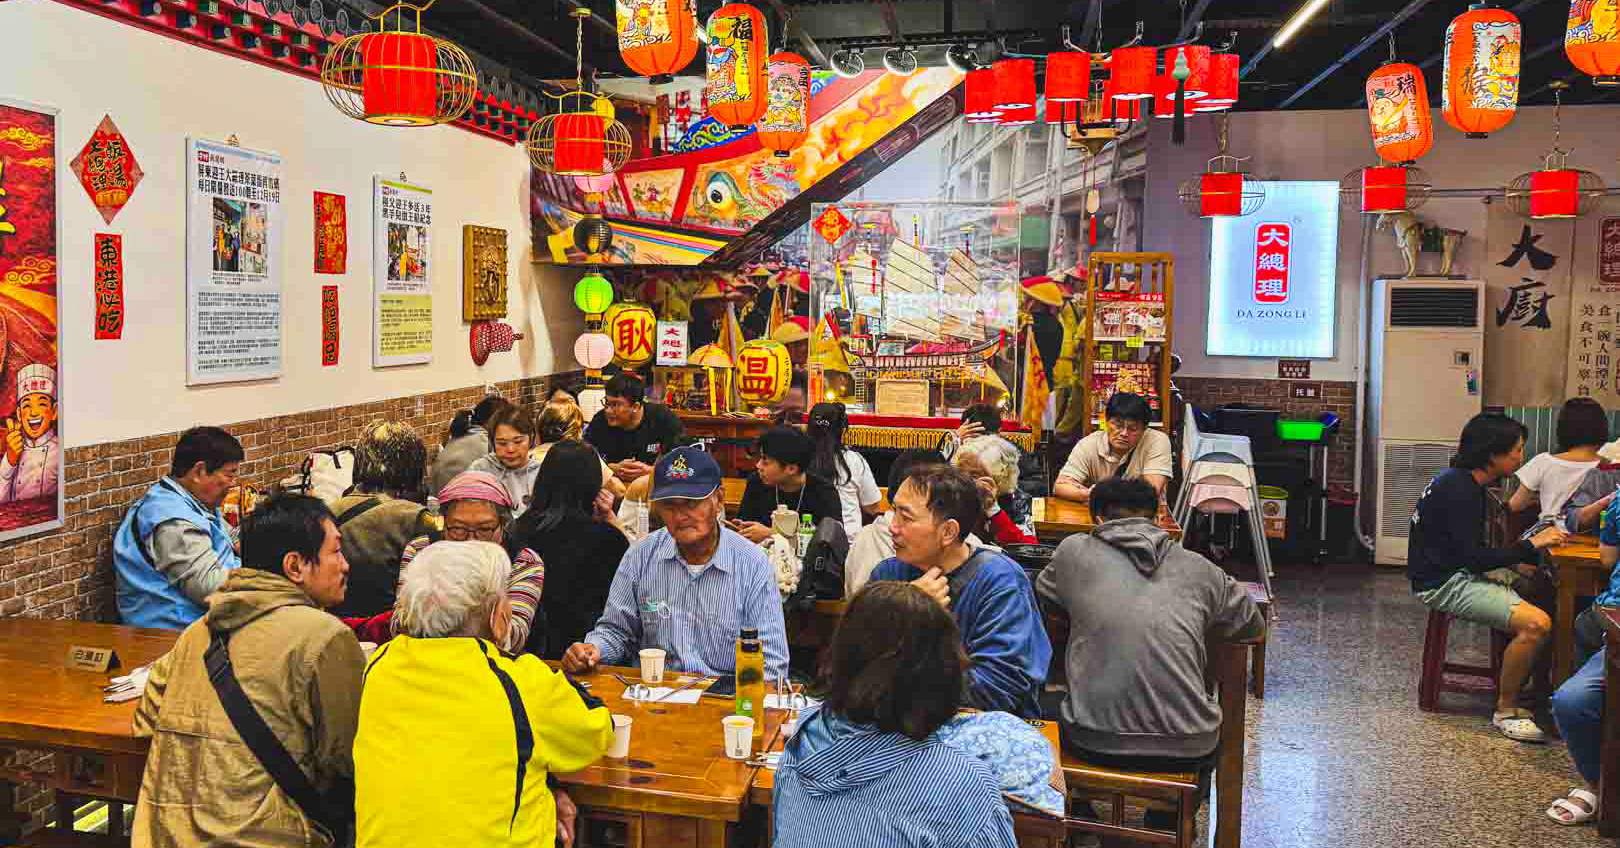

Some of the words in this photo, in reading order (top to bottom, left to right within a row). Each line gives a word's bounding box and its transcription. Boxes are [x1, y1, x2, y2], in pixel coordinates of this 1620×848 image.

[730, 17, 753, 41] 福
[1255, 228, 1289, 297] 大總理
[1495, 223, 1561, 331] 大廚
[1237, 309, 1253, 318] DA
[1256, 309, 1291, 319] ZONG
[1295, 309, 1306, 319] LI
[661, 329, 682, 358] 大總理
